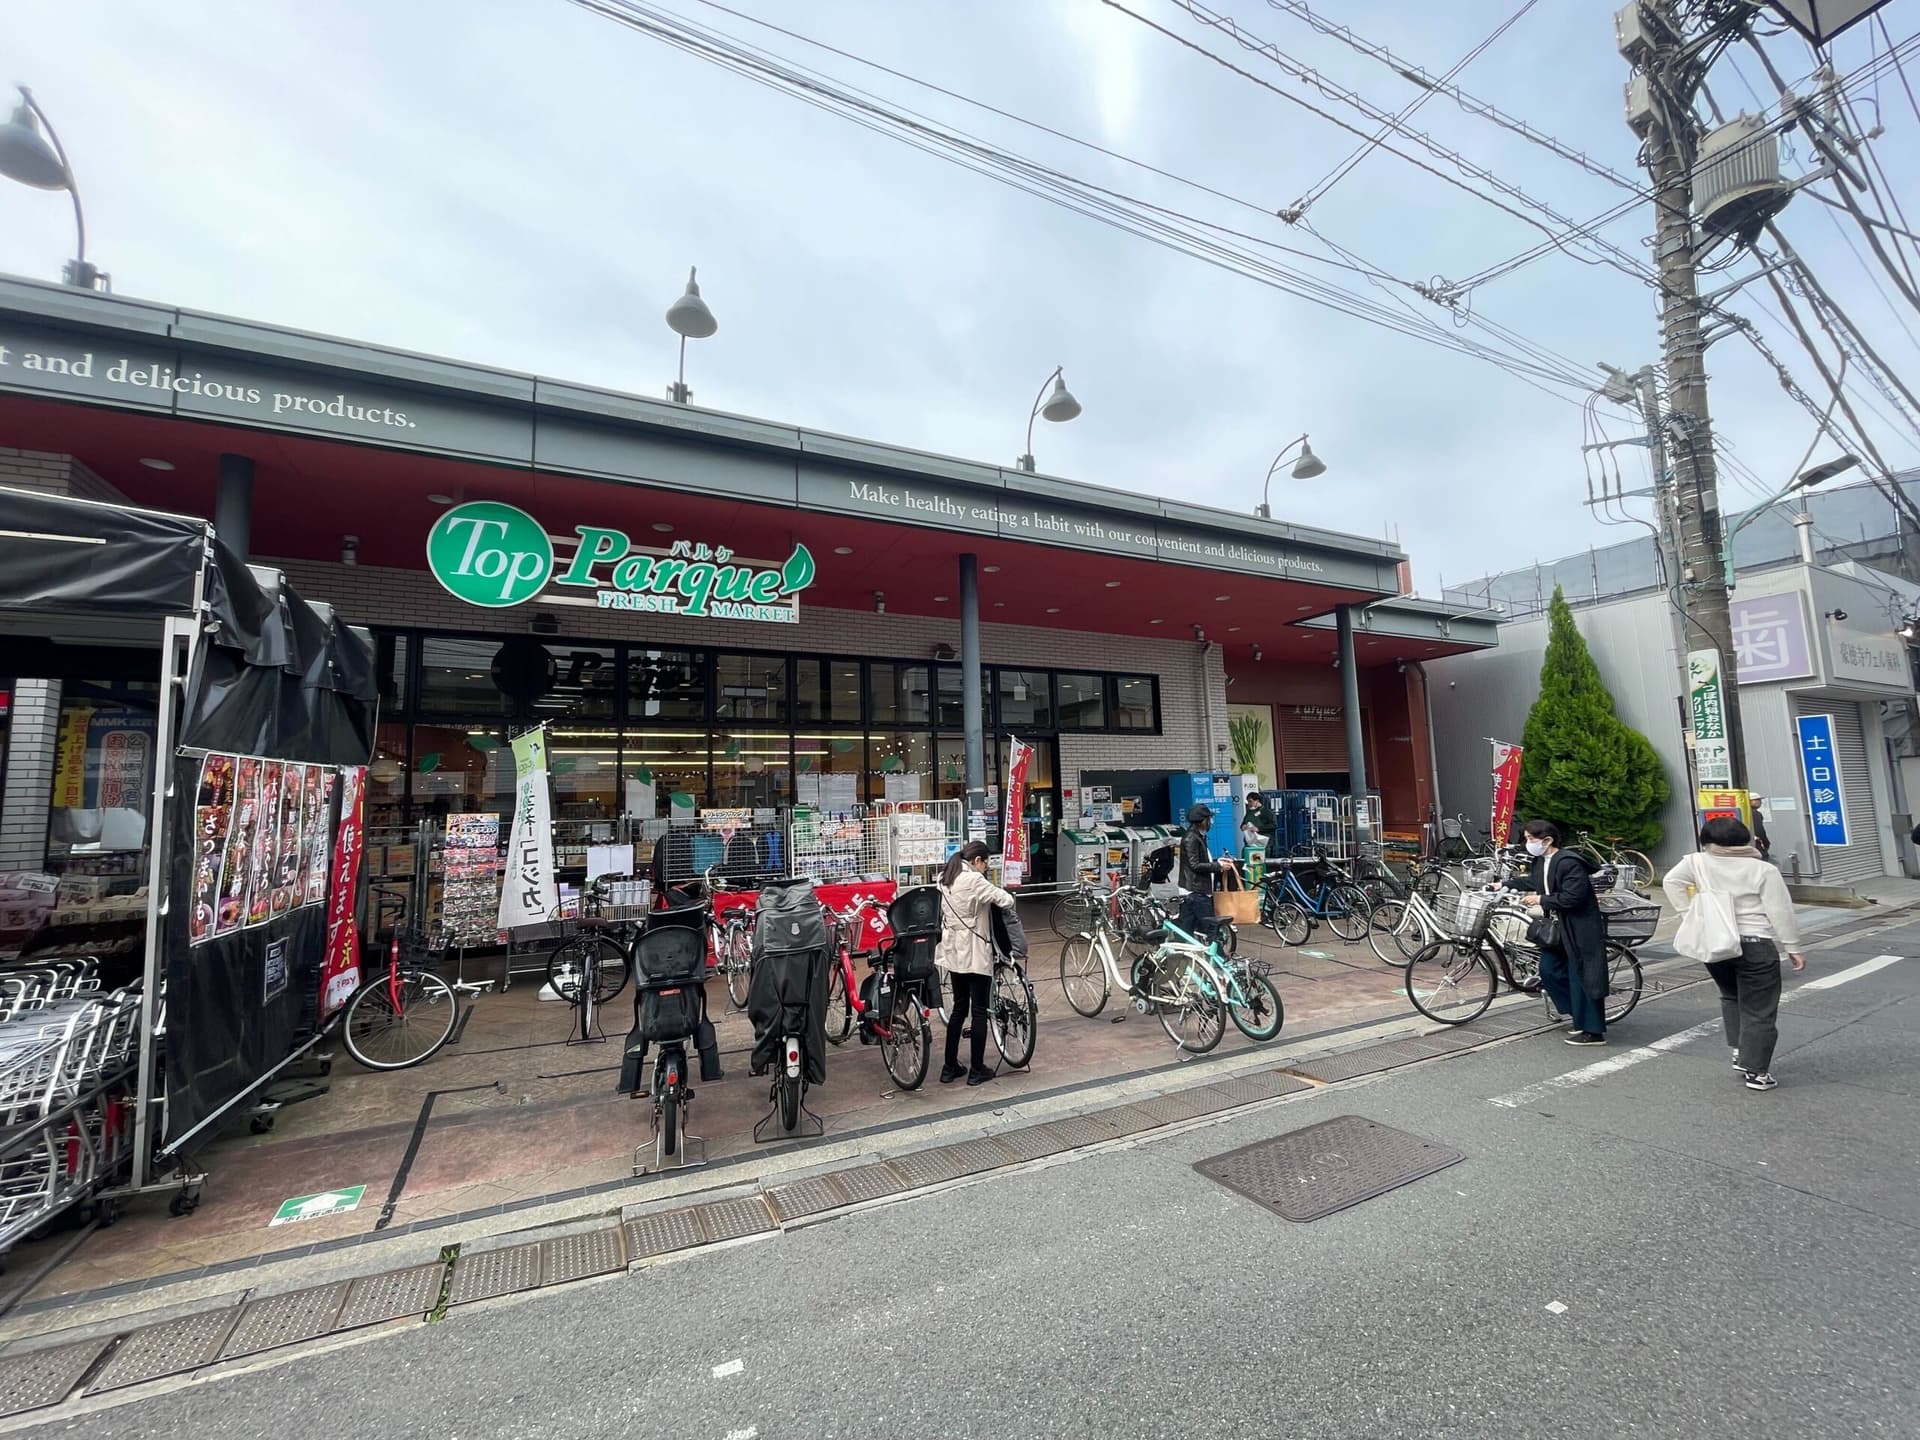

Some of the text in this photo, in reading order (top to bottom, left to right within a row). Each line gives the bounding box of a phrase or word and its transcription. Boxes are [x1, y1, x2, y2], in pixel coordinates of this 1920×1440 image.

[23, 353, 94, 378] and
[106, 359, 261, 404] delicious
[273, 394, 417, 428] products.
[446, 517, 544, 600] Top
[671, 539, 733, 563] パルケ
[849, 481, 1324, 573] Make healthy eating a habit with our convenient and delicious products.
[556, 525, 782, 617] Parque
[598, 591, 796, 624] FRESH MARKET
[1732, 610, 1790, 673] 歯
[1693, 696, 1704, 738] クリニック
[1805, 735, 1840, 826] 土・日診療
[195, 814, 218, 921] さつまいも
